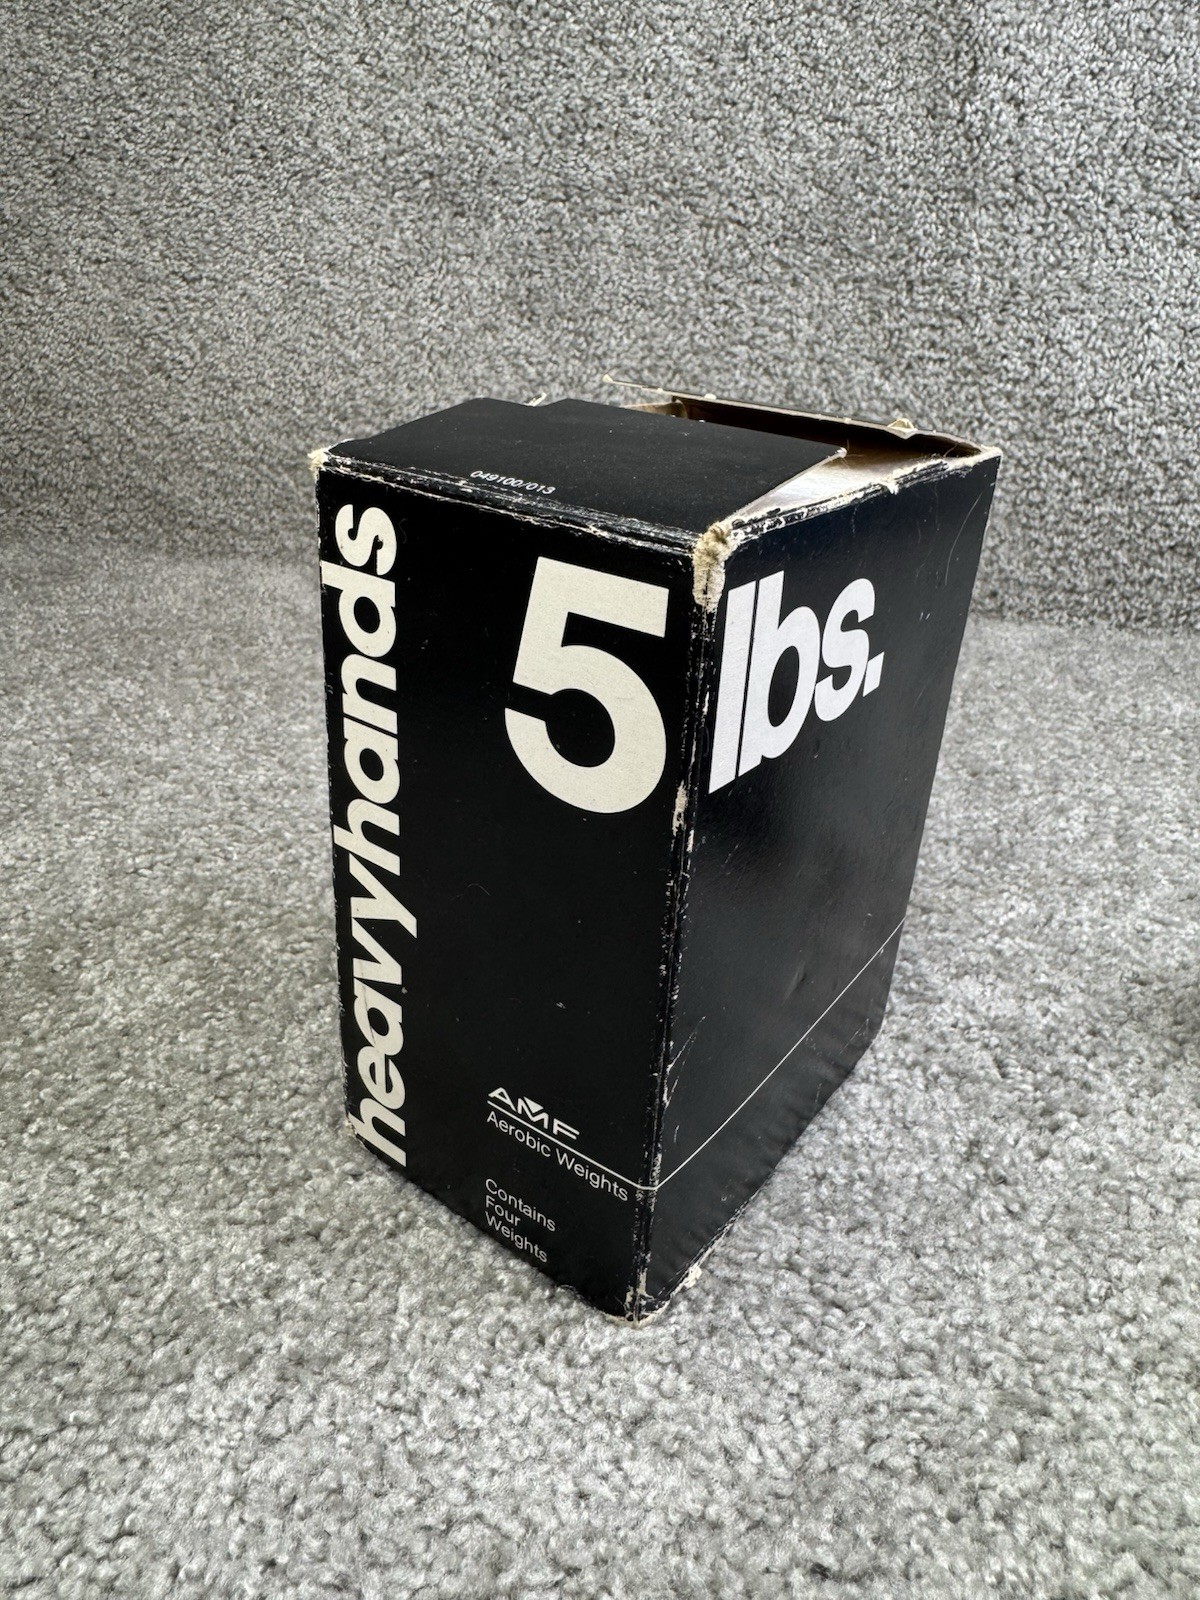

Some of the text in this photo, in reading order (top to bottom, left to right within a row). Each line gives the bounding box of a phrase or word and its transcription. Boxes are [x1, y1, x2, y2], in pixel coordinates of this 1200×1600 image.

[470, 470, 556, 495] 049100/013
[505, 556, 884, 813] 5 lbs.
[320, 503, 417, 1167] heavyhands
[488, 1087, 580, 1140] AMF
[487, 1111, 629, 1202] Aerobic Weights
[485, 1178, 556, 1232] Contains
[485, 1196, 521, 1227] Four
[485, 1212, 548, 1263] Weights
